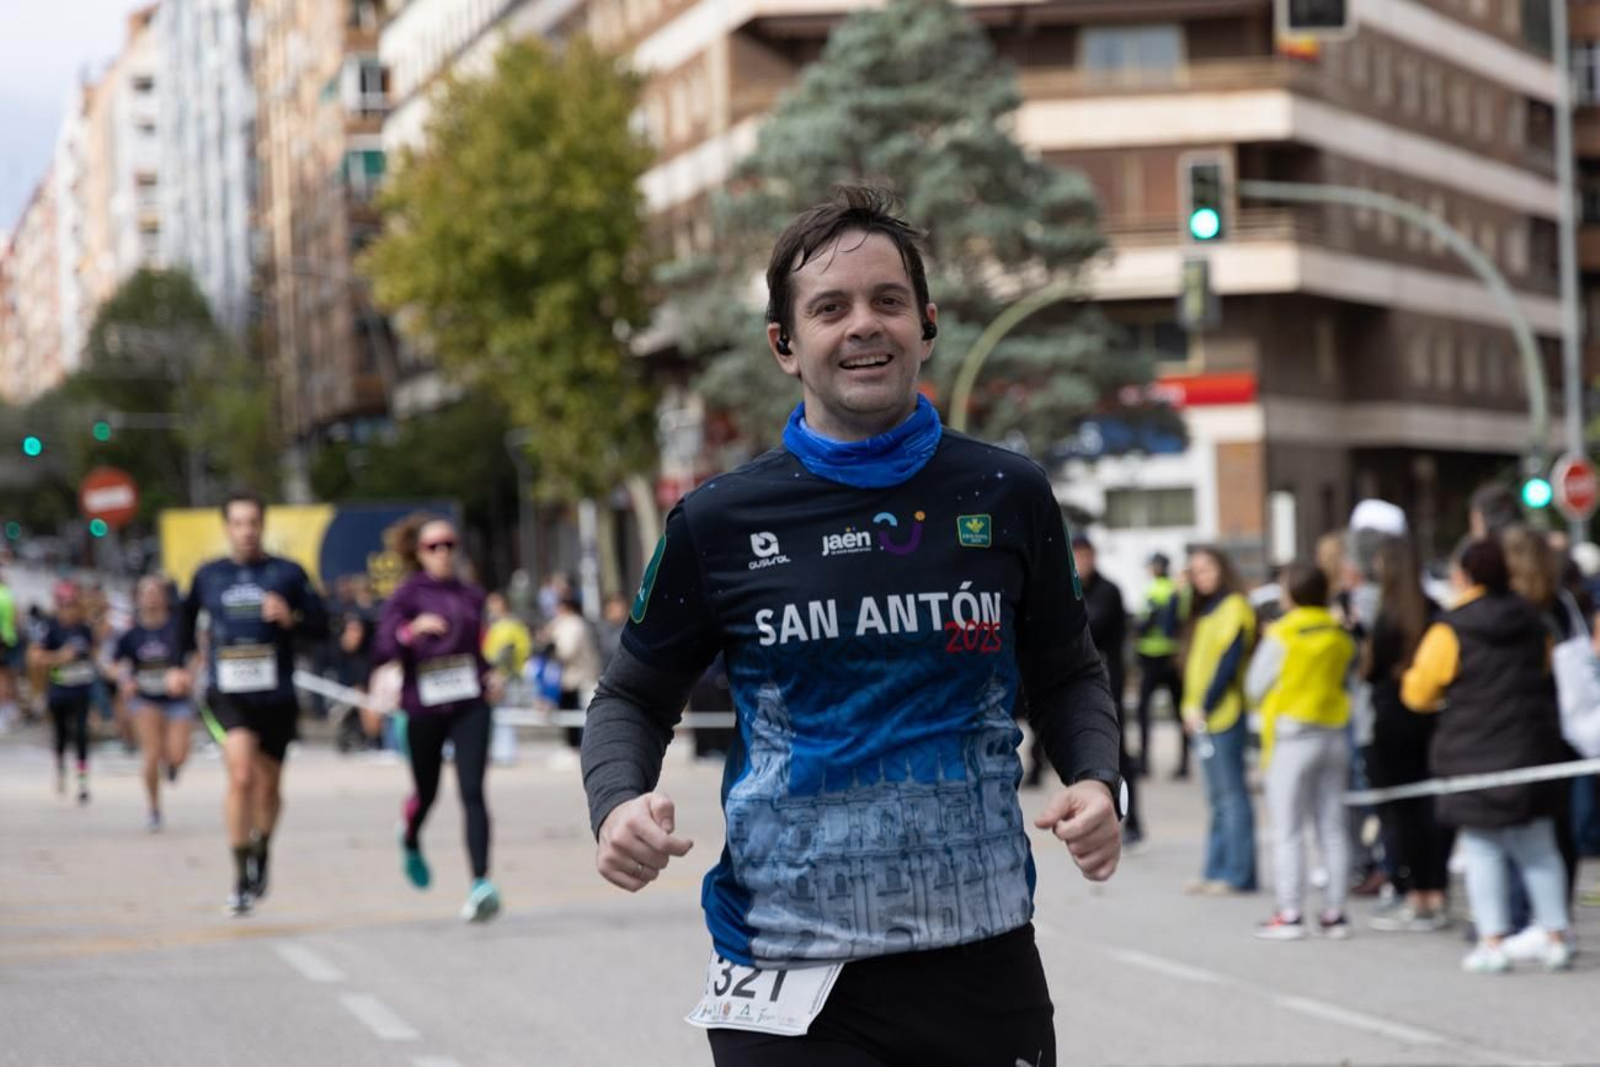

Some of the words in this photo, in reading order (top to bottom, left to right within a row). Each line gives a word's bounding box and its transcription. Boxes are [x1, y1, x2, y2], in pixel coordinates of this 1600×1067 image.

[755, 599, 840, 646] SAN
[855, 581, 1001, 636] ANTÓN
[945, 619, 1003, 653] 2025
